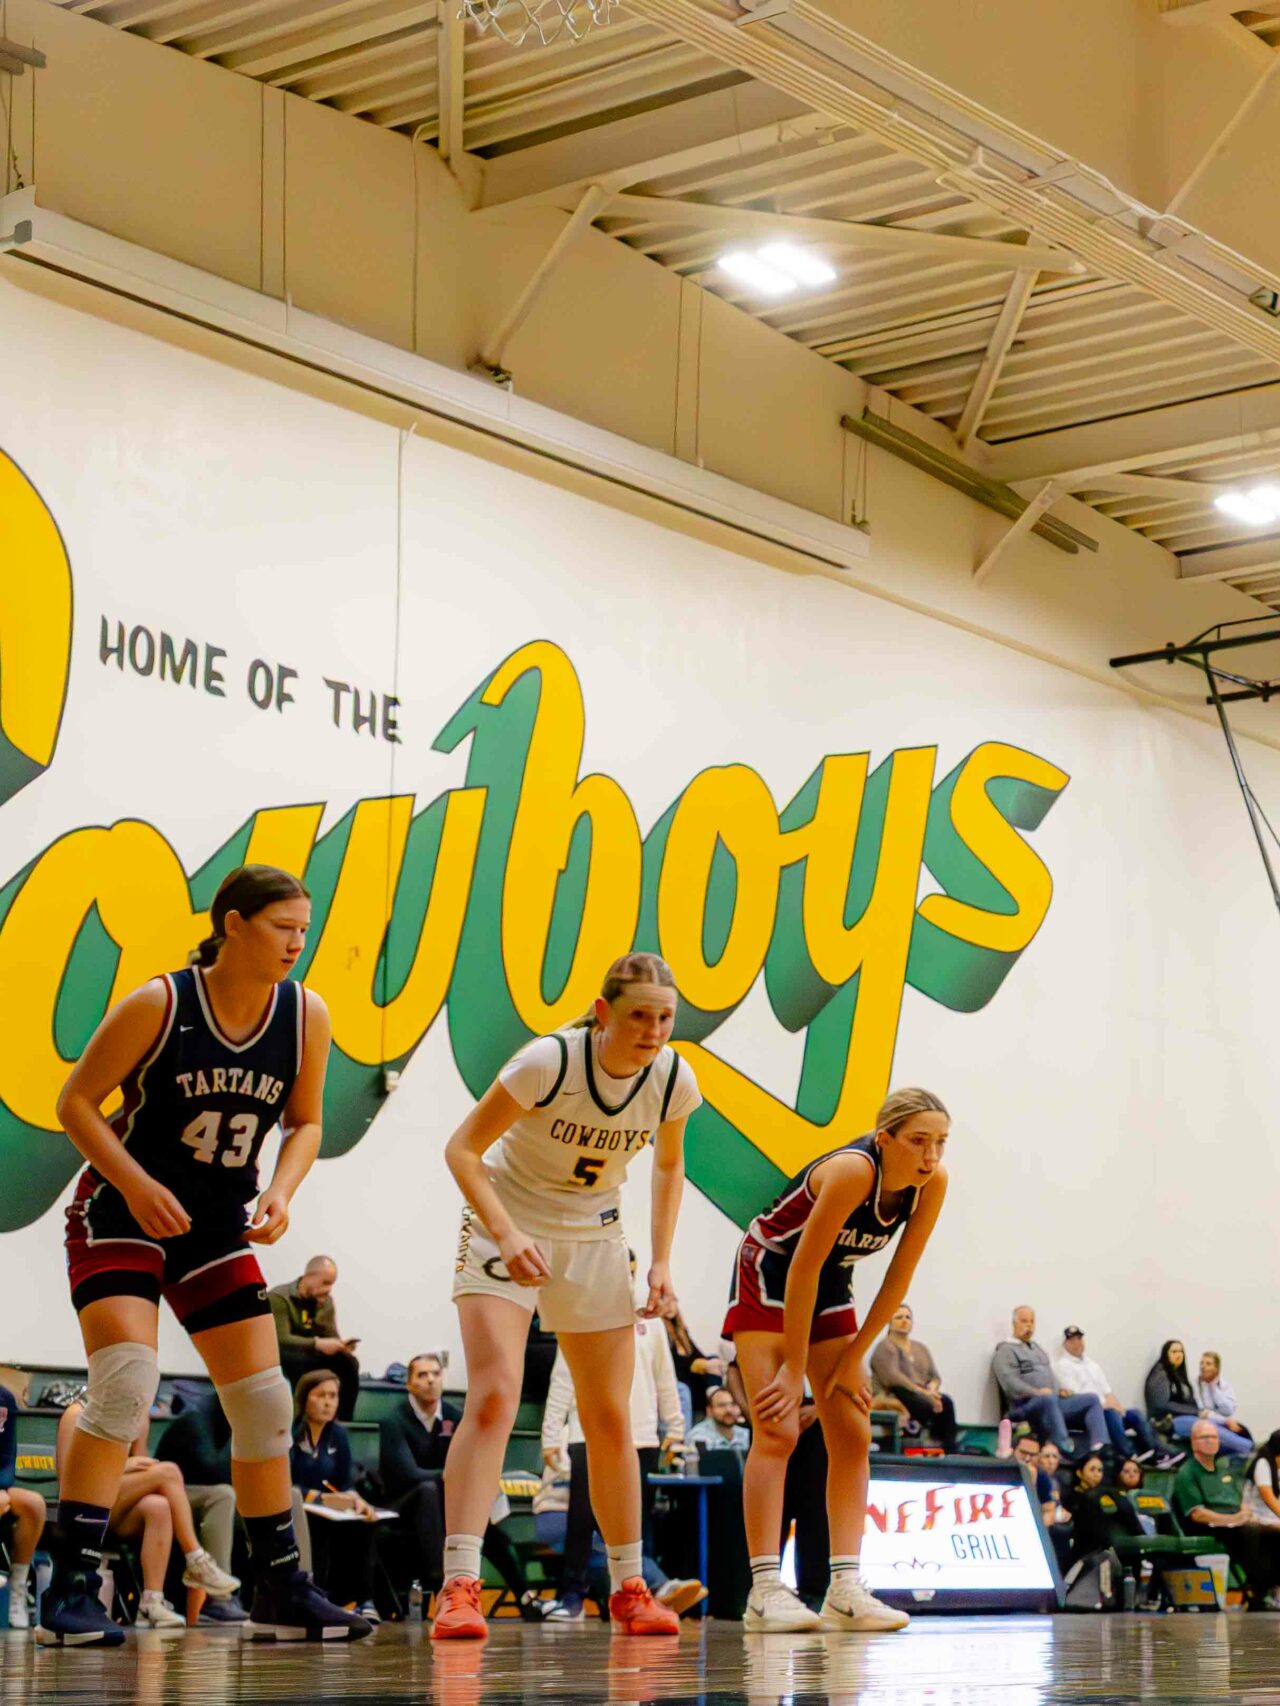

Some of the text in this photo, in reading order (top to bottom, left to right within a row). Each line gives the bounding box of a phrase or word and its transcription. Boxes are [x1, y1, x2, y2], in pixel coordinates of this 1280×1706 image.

[100, 613, 403, 745] HOME OF THE
[0, 446, 1071, 1235] owboys
[176, 1067, 285, 1105] TARTANS
[180, 1110, 260, 1168] 43
[550, 1119, 650, 1152] COWBOYS
[568, 1156, 608, 1187] 5
[864, 1485, 1021, 1534] NEFIRE
[951, 1534, 1021, 1561] GRILL
